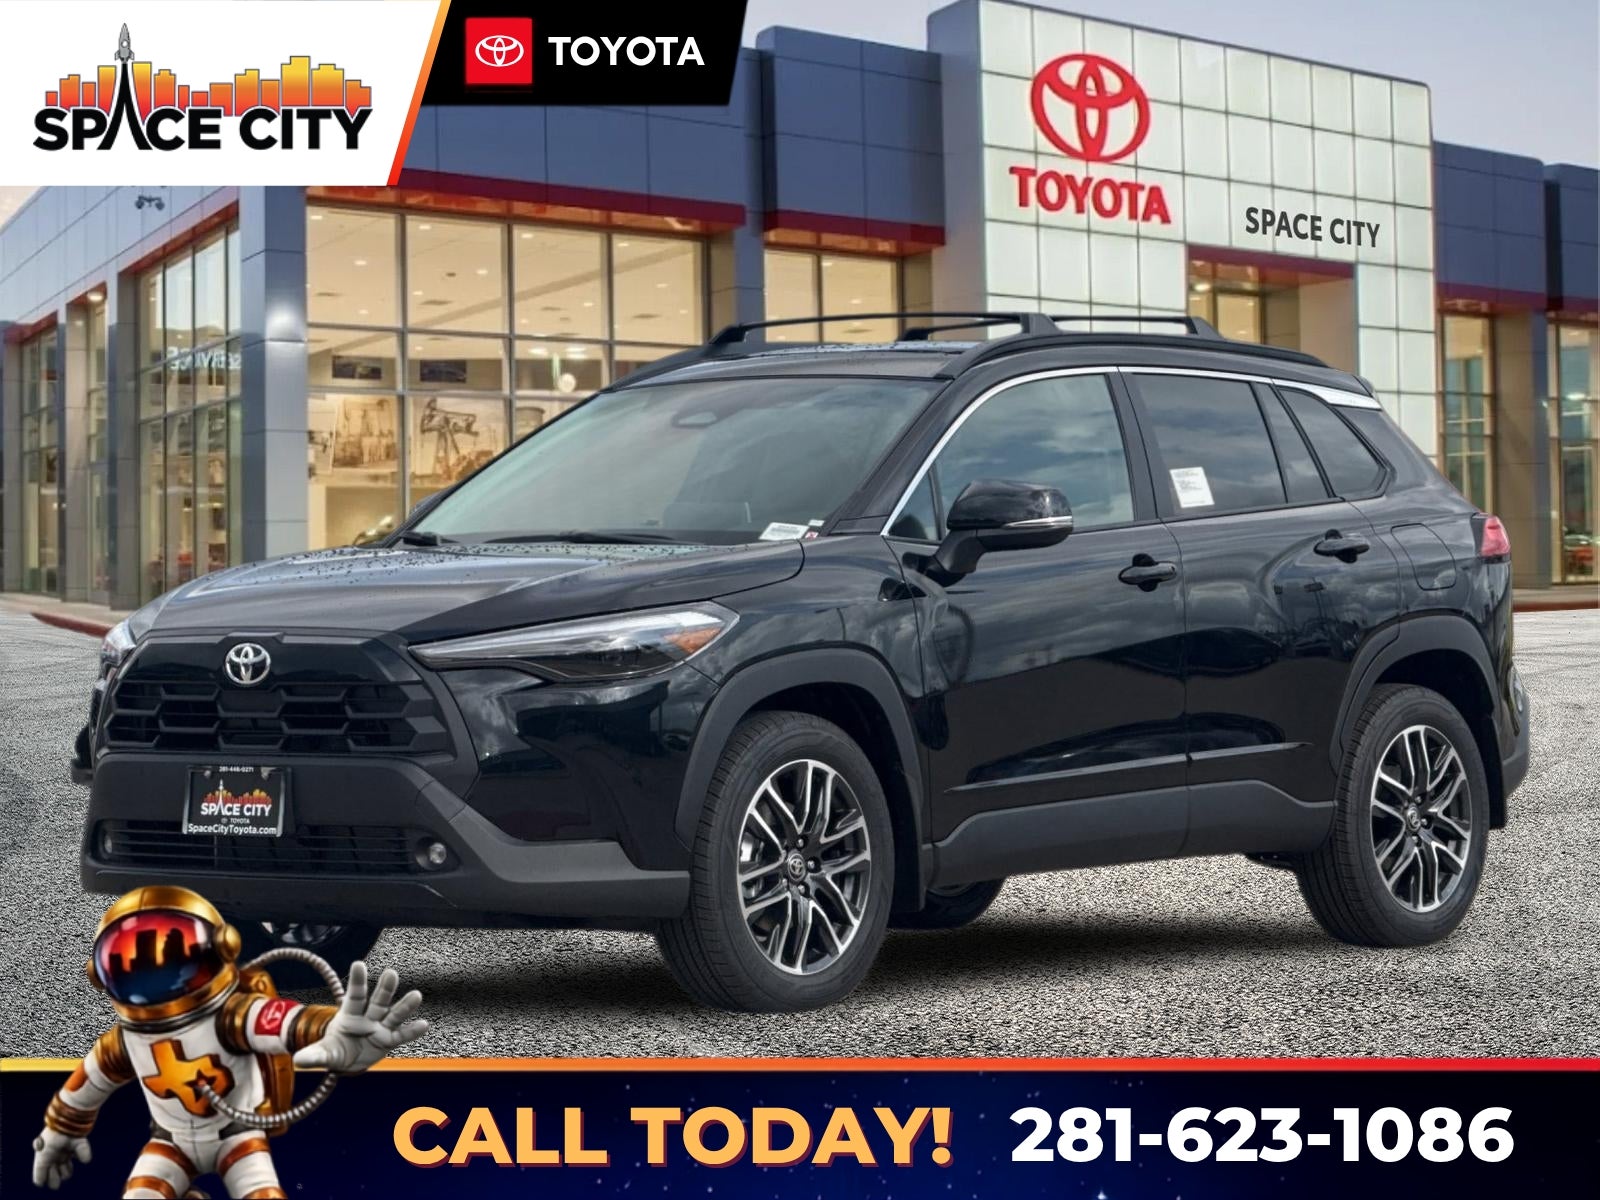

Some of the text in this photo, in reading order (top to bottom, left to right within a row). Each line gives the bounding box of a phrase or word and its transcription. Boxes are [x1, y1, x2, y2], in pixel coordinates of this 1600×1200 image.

[1008, 166, 1172, 225] TOYOTA
[1244, 206, 1381, 249] SPACE CITY
[200, 801, 272, 816] SPACE CITY
[188, 823, 278, 836] SpaceCityToyota.com
